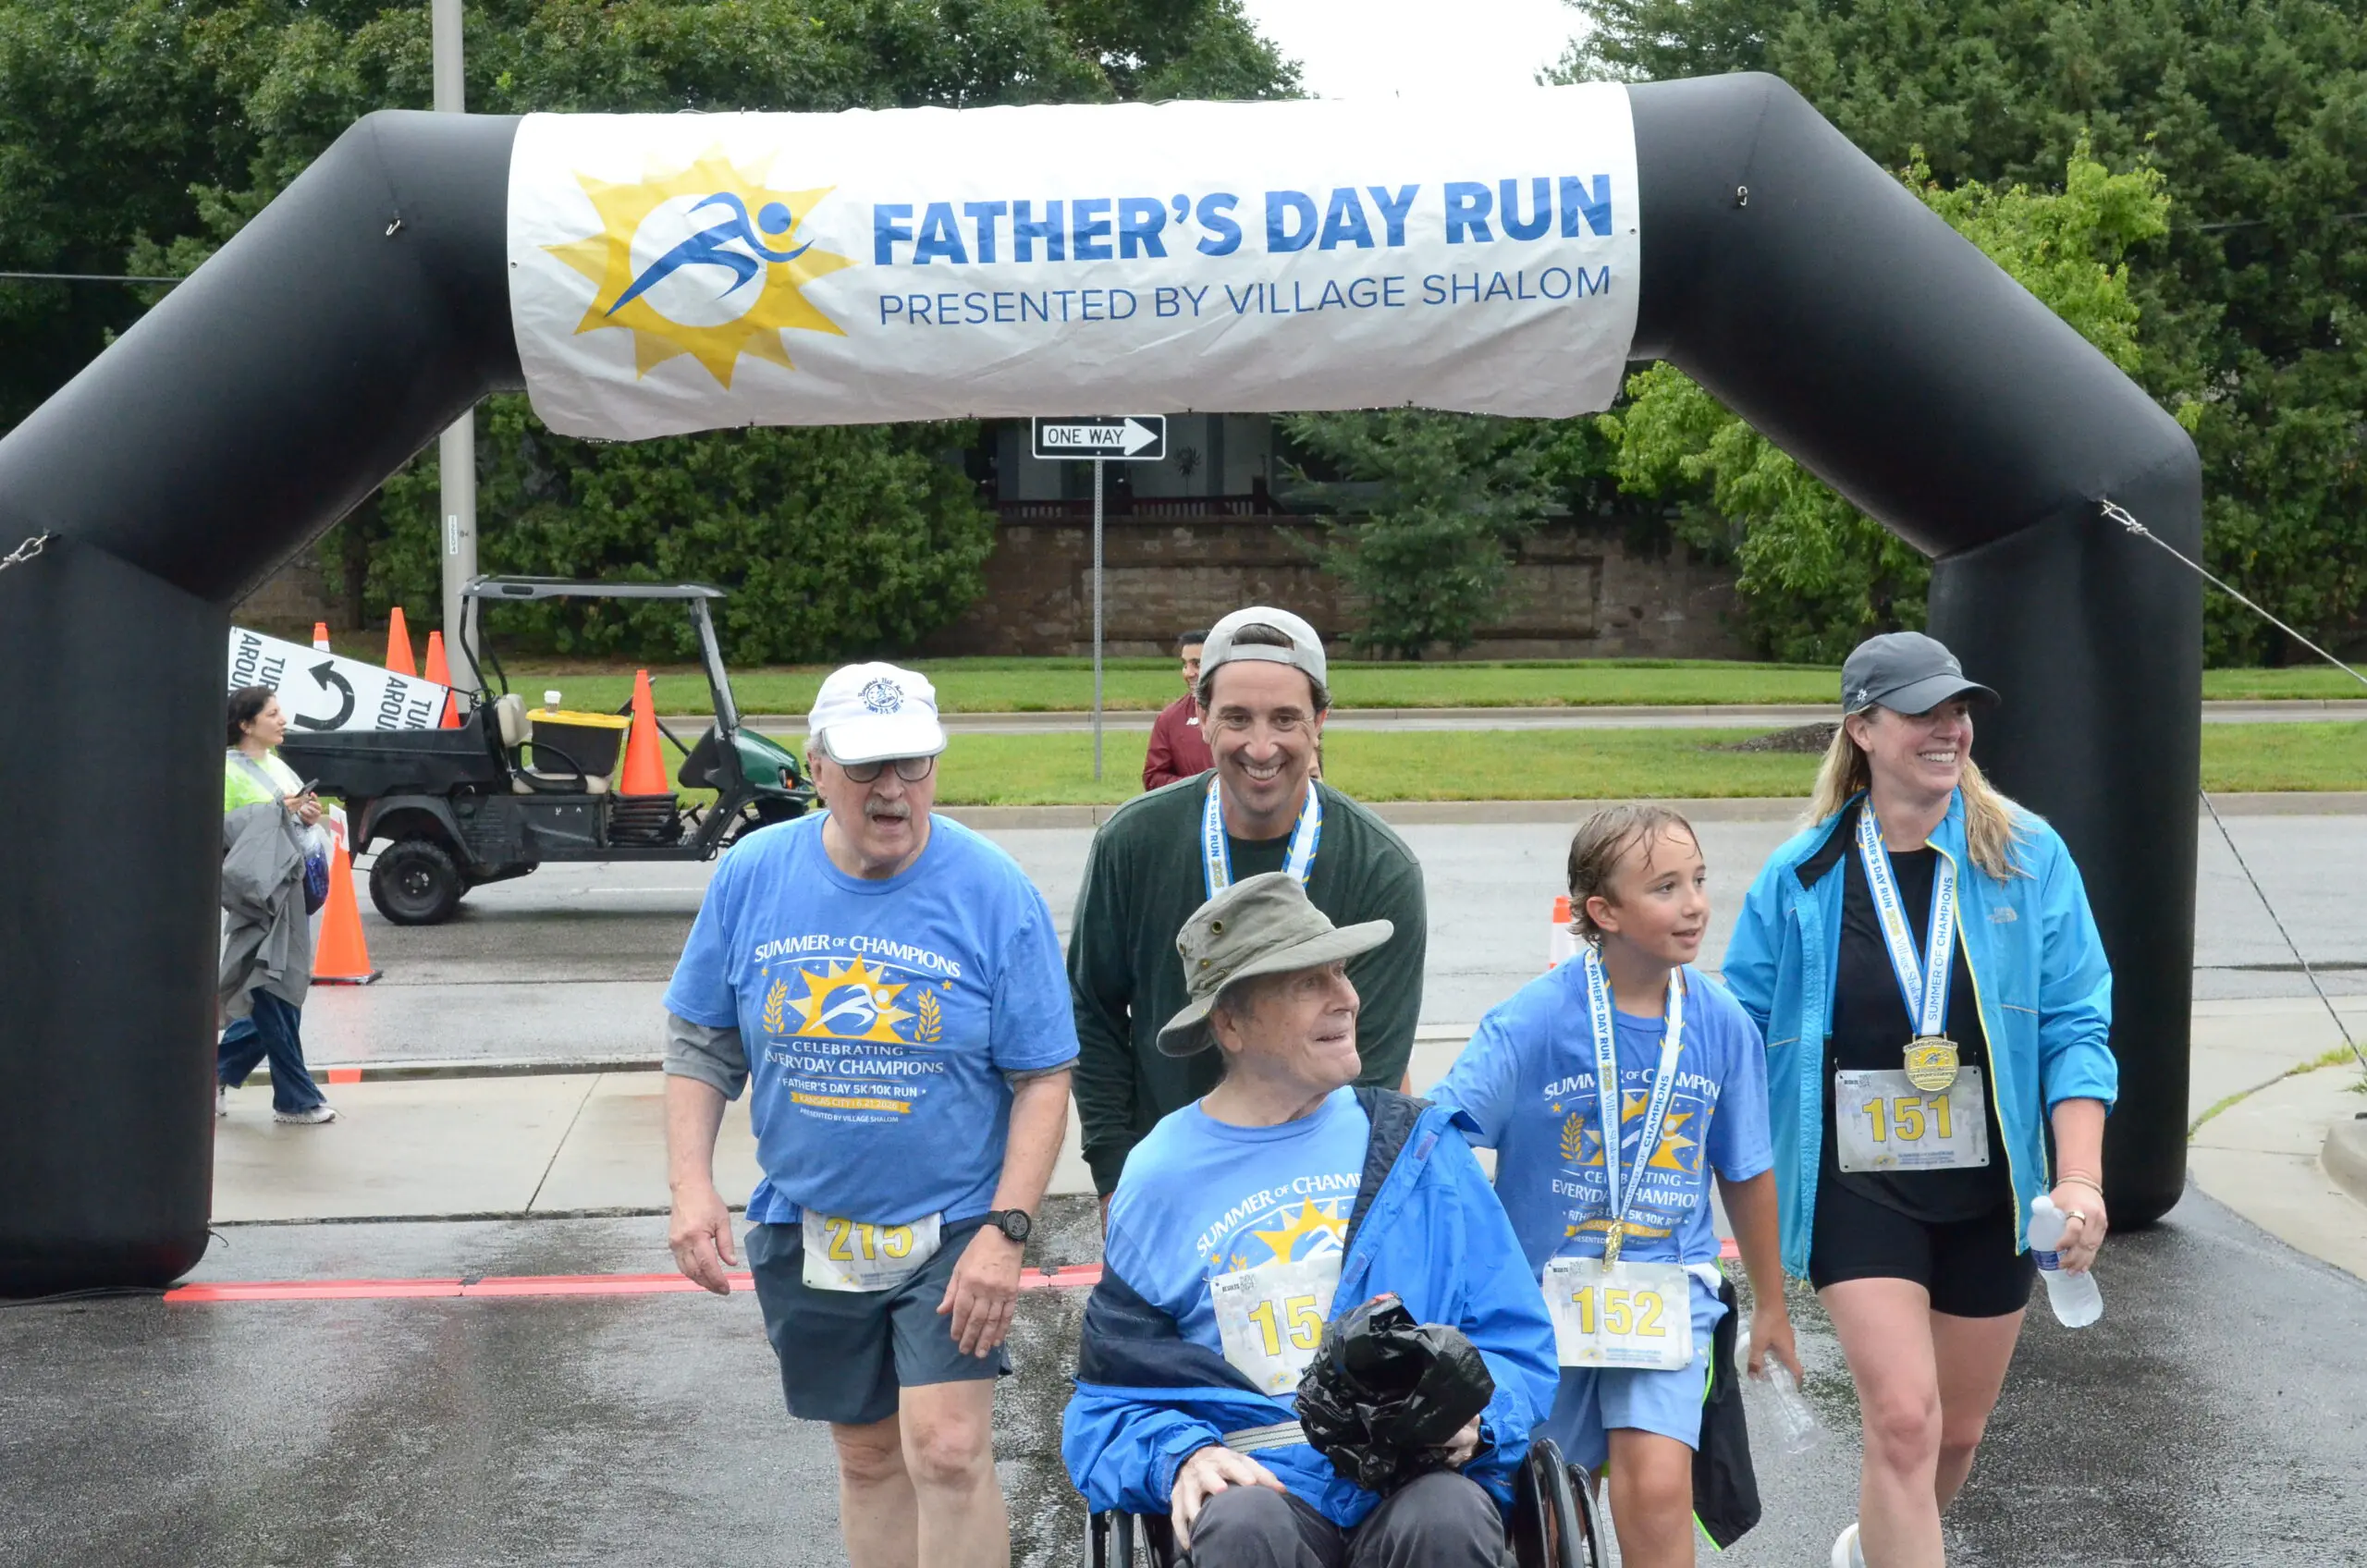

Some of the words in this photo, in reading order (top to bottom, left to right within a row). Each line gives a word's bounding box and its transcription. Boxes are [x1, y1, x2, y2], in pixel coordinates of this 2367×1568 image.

[873, 192, 1243, 265] FATHER'S
[1265, 183, 1421, 253] DAY
[1443, 174, 1613, 245] RUN
[879, 288, 1138, 325] PRESENTED
[1155, 285, 1209, 318] BY
[1224, 276, 1405, 314] VILLAGE
[1422, 265, 1610, 306] SHALOM
[1048, 428, 1082, 444] ONE
[1089, 428, 1124, 444] WAY
[1209, 835, 1220, 858] RUN
[1864, 821, 1880, 864] FATHER'S
[1873, 865, 1887, 885] DAY
[1880, 887, 1893, 909] RUN
[1936, 876, 1954, 947] CHAMPIONS
[754, 934, 831, 962] SUMMER
[832, 937, 847, 948] OF
[849, 935, 962, 978] CHAMPIONS
[1934, 949, 1945, 970] OF
[1588, 963, 1605, 1011] FATHER'S
[1928, 971, 1943, 1021] SUMMER
[1596, 1013, 1609, 1035] DAY
[765, 1048, 836, 1073] EVERYDAY
[839, 1060, 944, 1075] CHAMPIONS
[792, 1041, 904, 1056] CELEBRATING
[1600, 1036, 1611, 1061] RUN
[782, 1078, 828, 1093] FATHER'S
[829, 1084, 851, 1095] DAY
[893, 1086, 918, 1097] RUN
[1626, 1071, 1640, 1080] OF
[842, 1113, 868, 1123] VILLAGE
[869, 1115, 899, 1123] SHALOM
[1643, 1074, 1670, 1147] CHAMPIONS
[1862, 1095, 1953, 1143] 151
[824, 1217, 914, 1261] 215
[1196, 1189, 1276, 1258] SUMMER
[1274, 1184, 1290, 1198] OF
[1248, 1294, 1324, 1357] 15
[1572, 1286, 1666, 1337] 152
